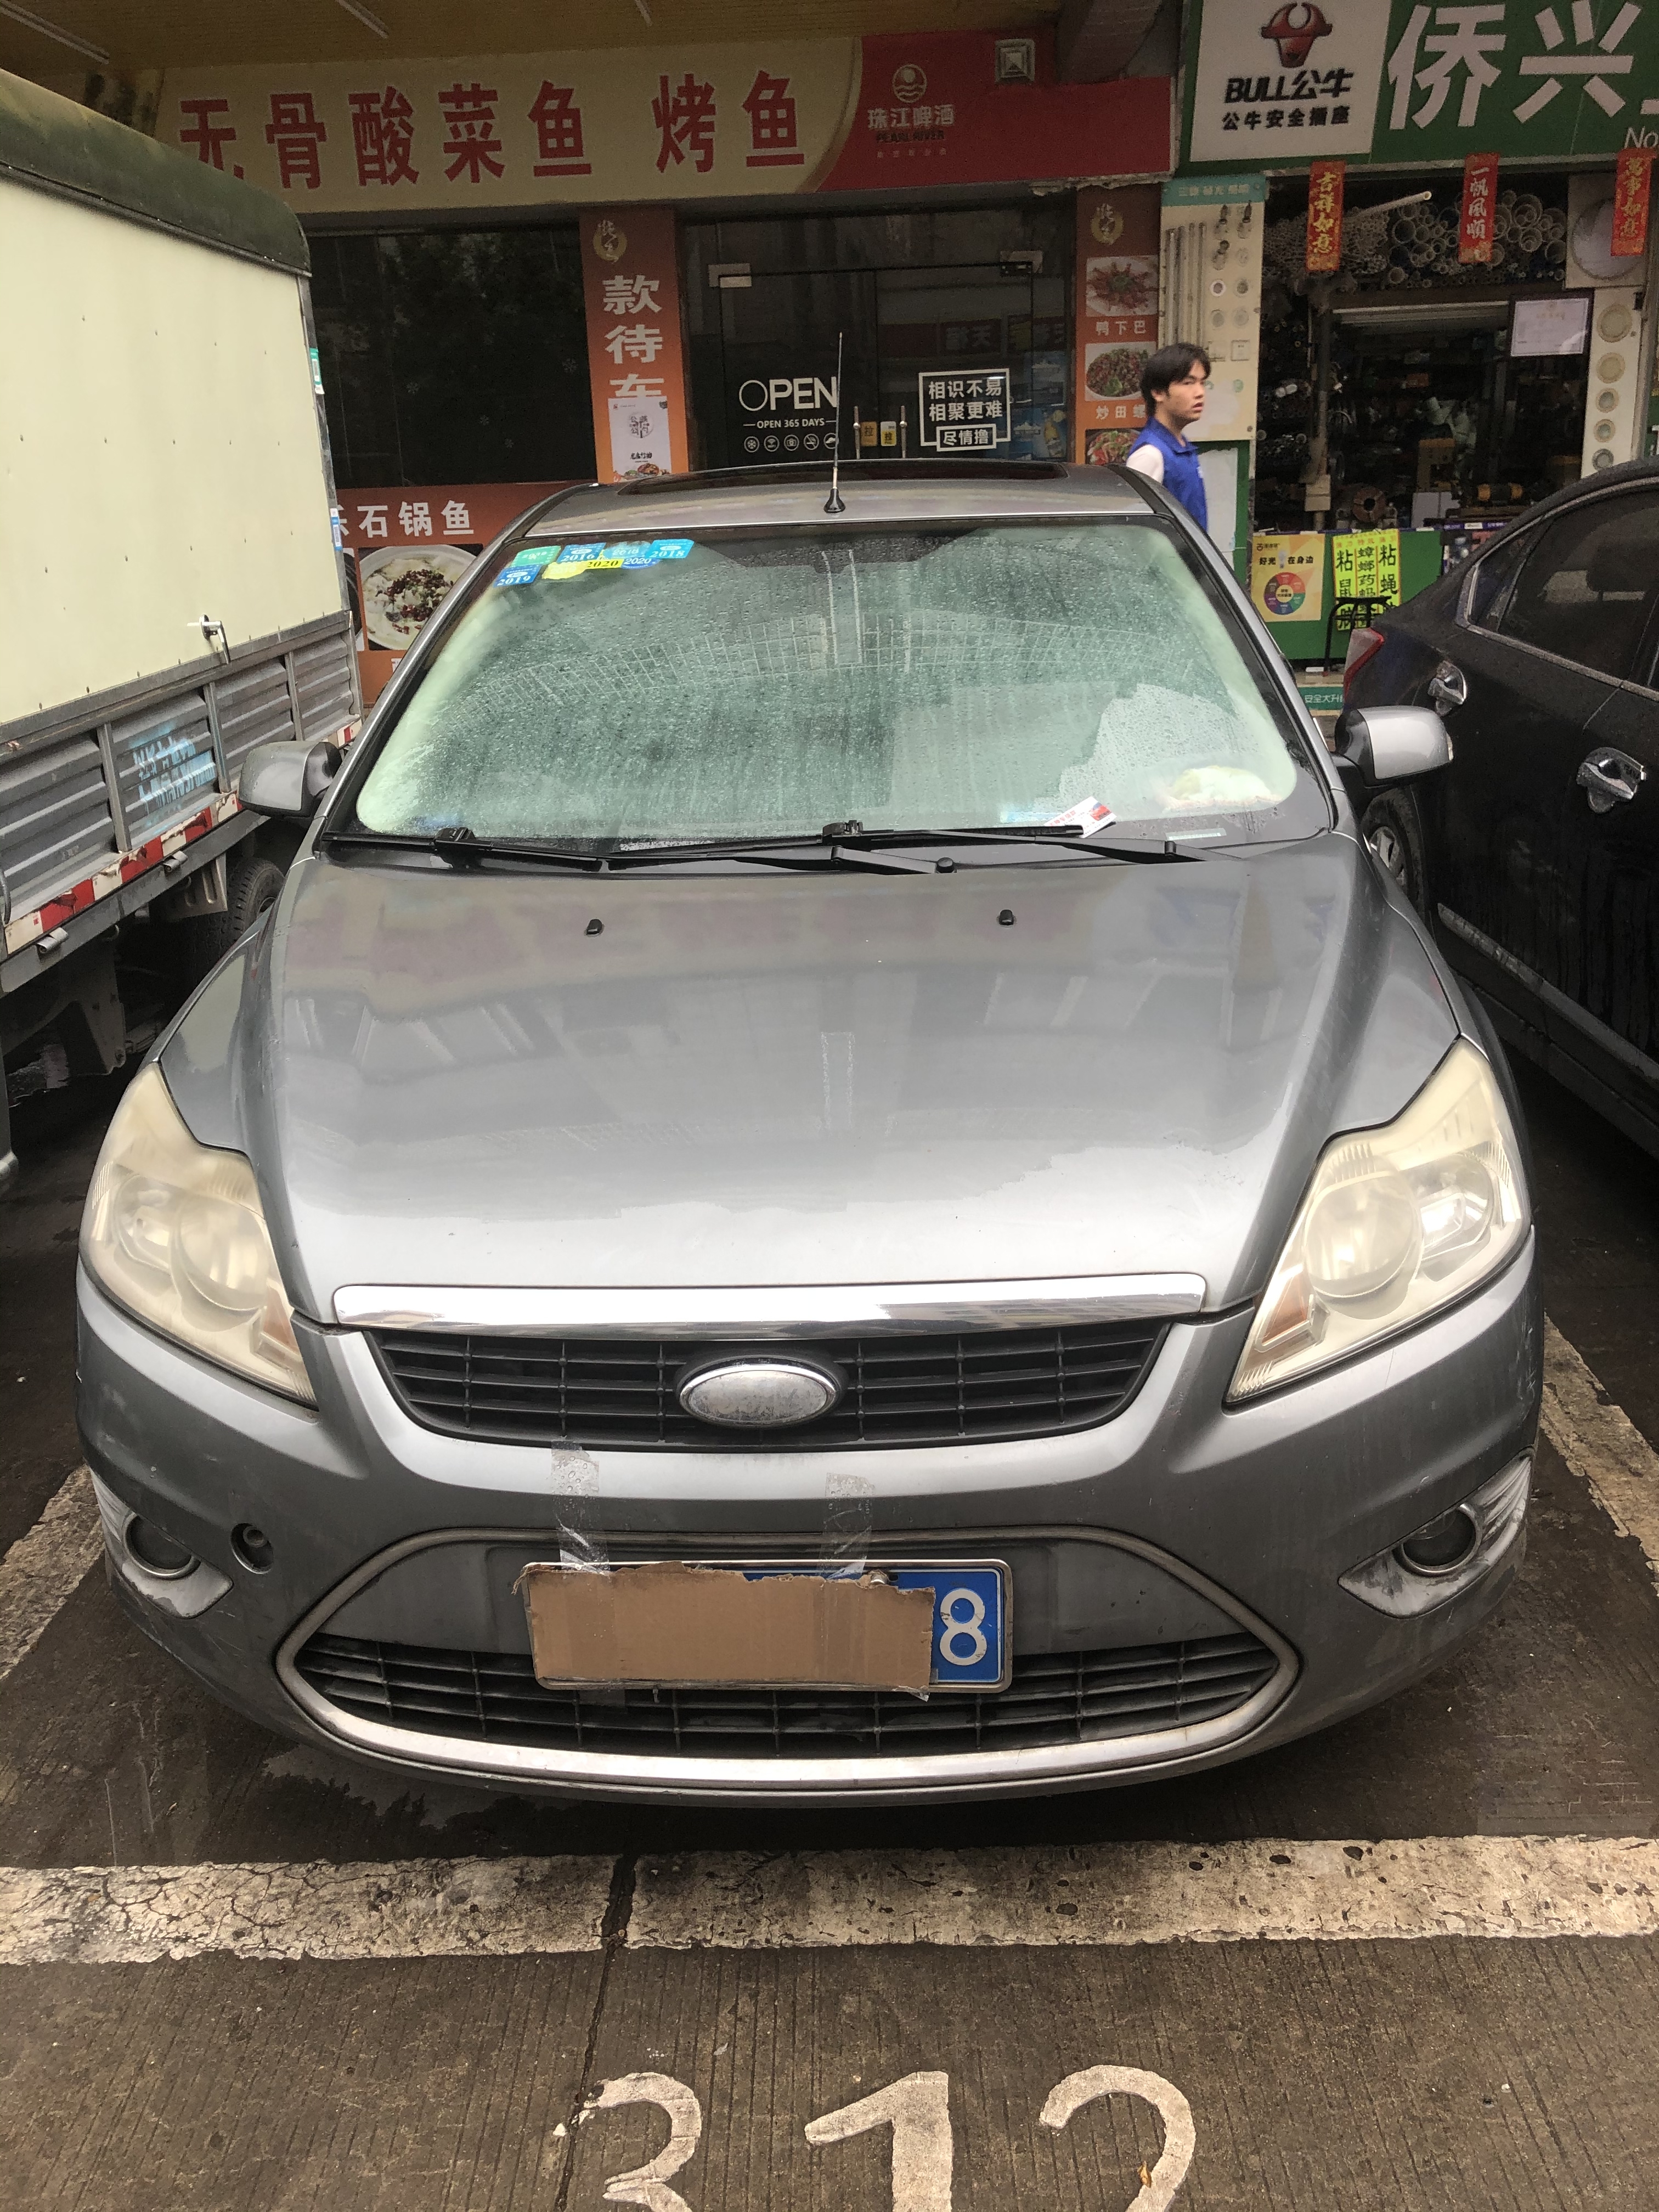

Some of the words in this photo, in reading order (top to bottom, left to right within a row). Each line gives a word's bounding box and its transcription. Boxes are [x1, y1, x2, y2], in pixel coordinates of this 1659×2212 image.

[1388, 1, 1659, 129] 侨兴
[652, 70, 805, 173] 烤鱼
[1221, 105, 1350, 131] 公牛安全插座
[1312, 171, 1336, 253] 吉祥如意
[739, 376, 838, 411] OPEN
[928, 378, 1003, 400] 相识不易
[928, 399, 1003, 422] 相聚更难
[757, 420, 781, 428] OPEN
[784, 419, 800, 428] 365
[802, 418, 825, 427] DAYS
[943, 428, 989, 446] 尽情撸
[560, 554, 595, 562] 2016
[648, 550, 686, 558] 2018
[496, 575, 531, 586] 2019
[939, 1588, 987, 1667] 8
